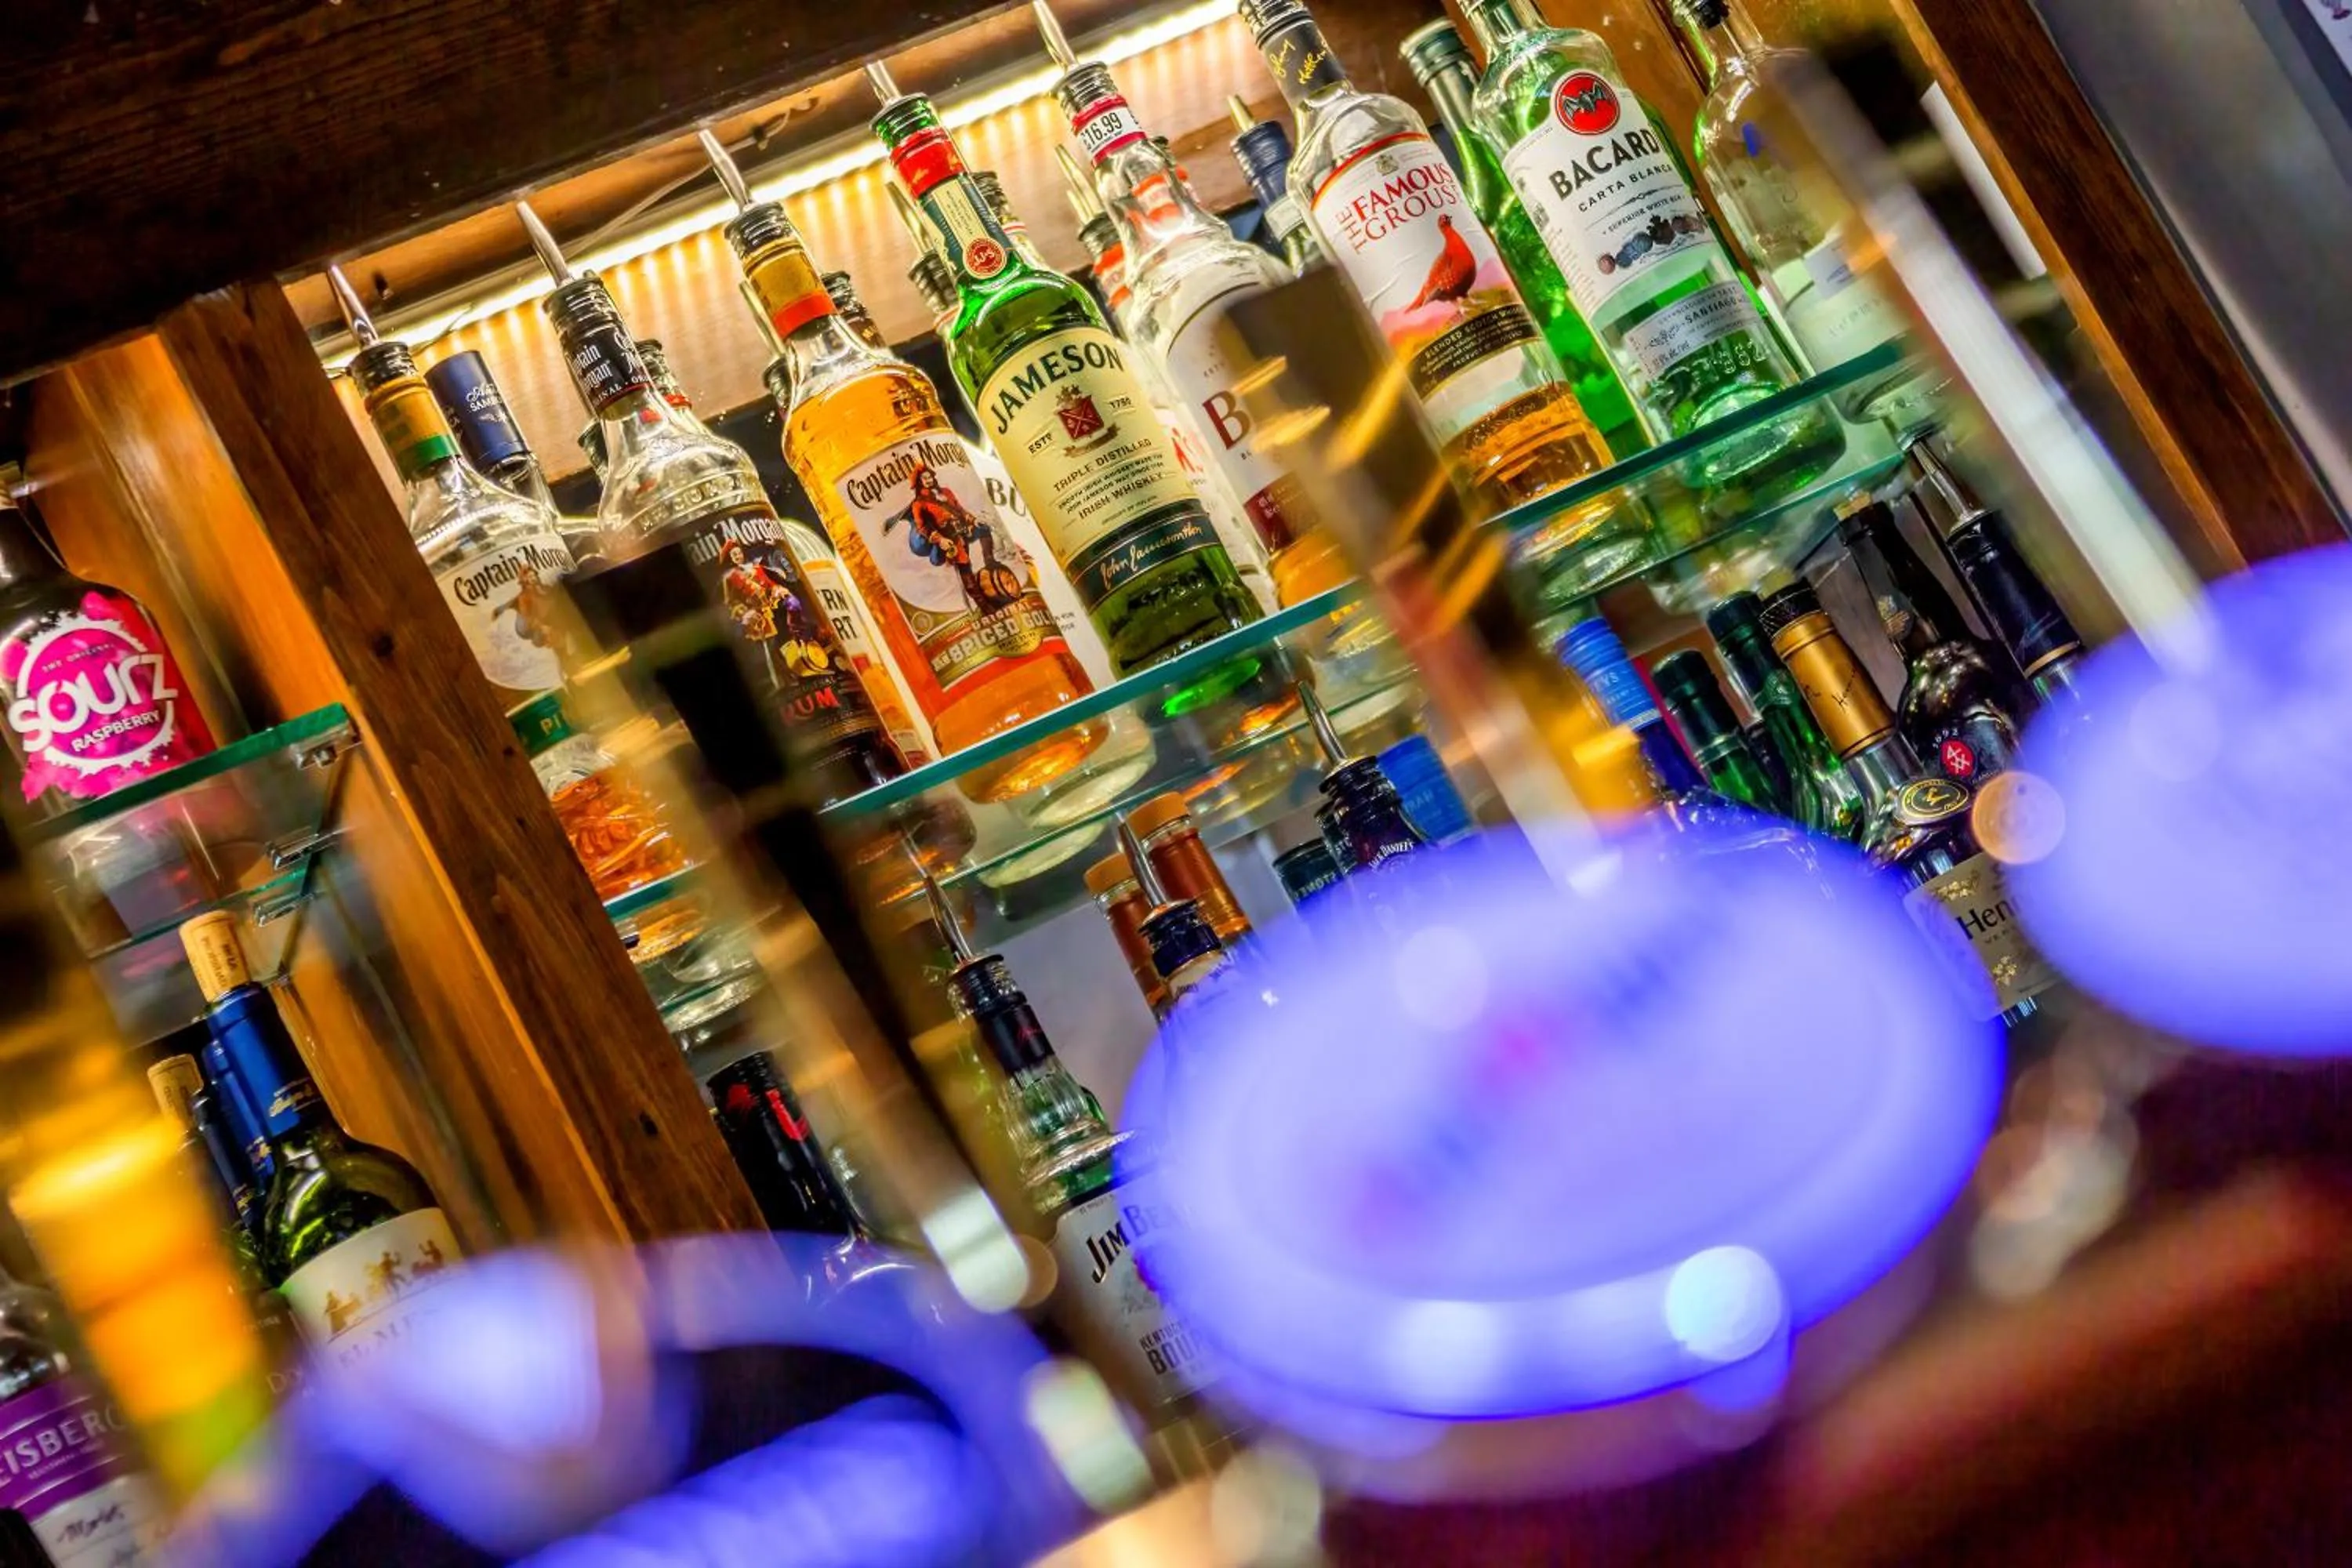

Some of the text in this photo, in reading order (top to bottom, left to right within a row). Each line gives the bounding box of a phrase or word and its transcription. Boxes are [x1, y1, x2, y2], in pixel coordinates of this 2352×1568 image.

[1548, 127, 1661, 201] BACARD
[1578, 163, 1673, 212] CARTA BLANCA
[1334, 205, 1367, 256] THE
[1352, 162, 1454, 223] FAMOUS
[988, 340, 1125, 436] JAMESON
[1203, 390, 1251, 451] B
[847, 438, 971, 510] Captain Morg
[1053, 463, 1094, 493] TRIPLE
[1095, 437, 1152, 466] DISTILLED
[1078, 495, 1112, 520] IRISH
[1112, 472, 1163, 499] WHISKEY
[453, 543, 578, 606] Captain Morg
[948, 618, 1020, 664] SPICED
[71, 710, 161, 753] RASPBERRY
[1086, 1221, 1131, 1284] JIM
[0, 1403, 126, 1488] ISBER
